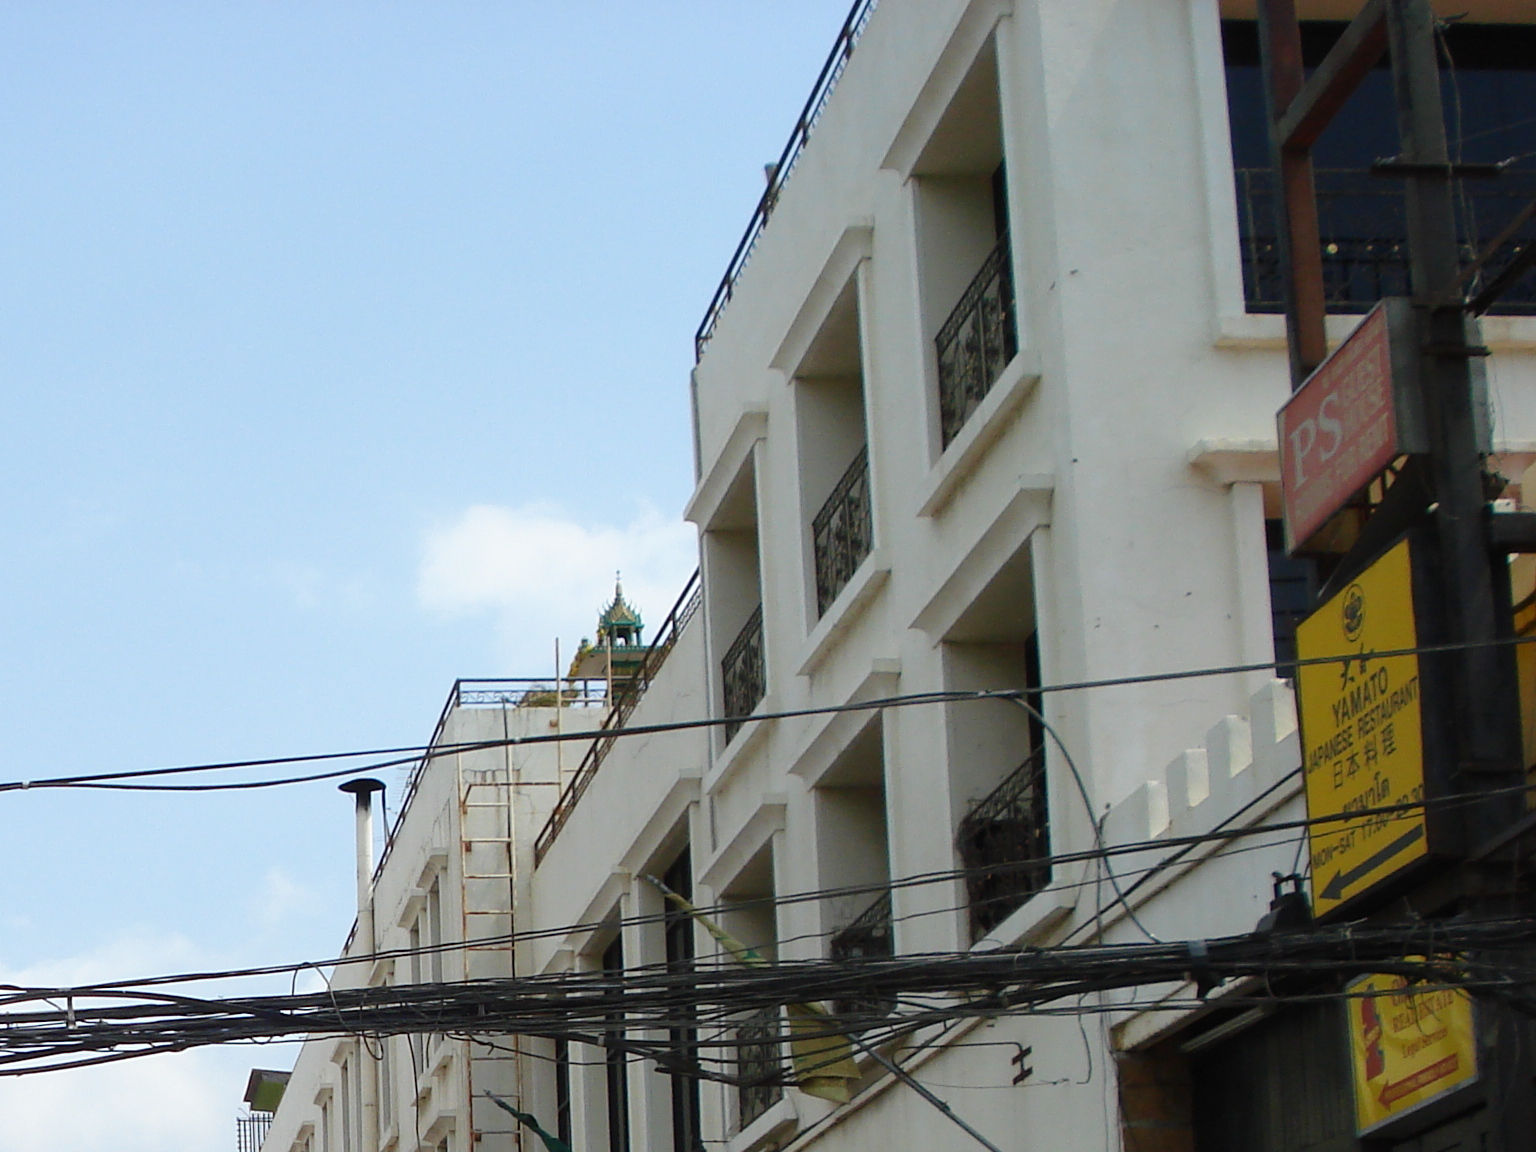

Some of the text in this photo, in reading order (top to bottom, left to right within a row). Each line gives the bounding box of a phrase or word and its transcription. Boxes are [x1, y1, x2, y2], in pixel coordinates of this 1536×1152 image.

[1289, 391, 1342, 491] PS
[1307, 676, 1419, 775] JAPANESE RESTAURANT
[1332, 666, 1388, 729] YAMATO
[1333, 723, 1397, 790] 日本料理
